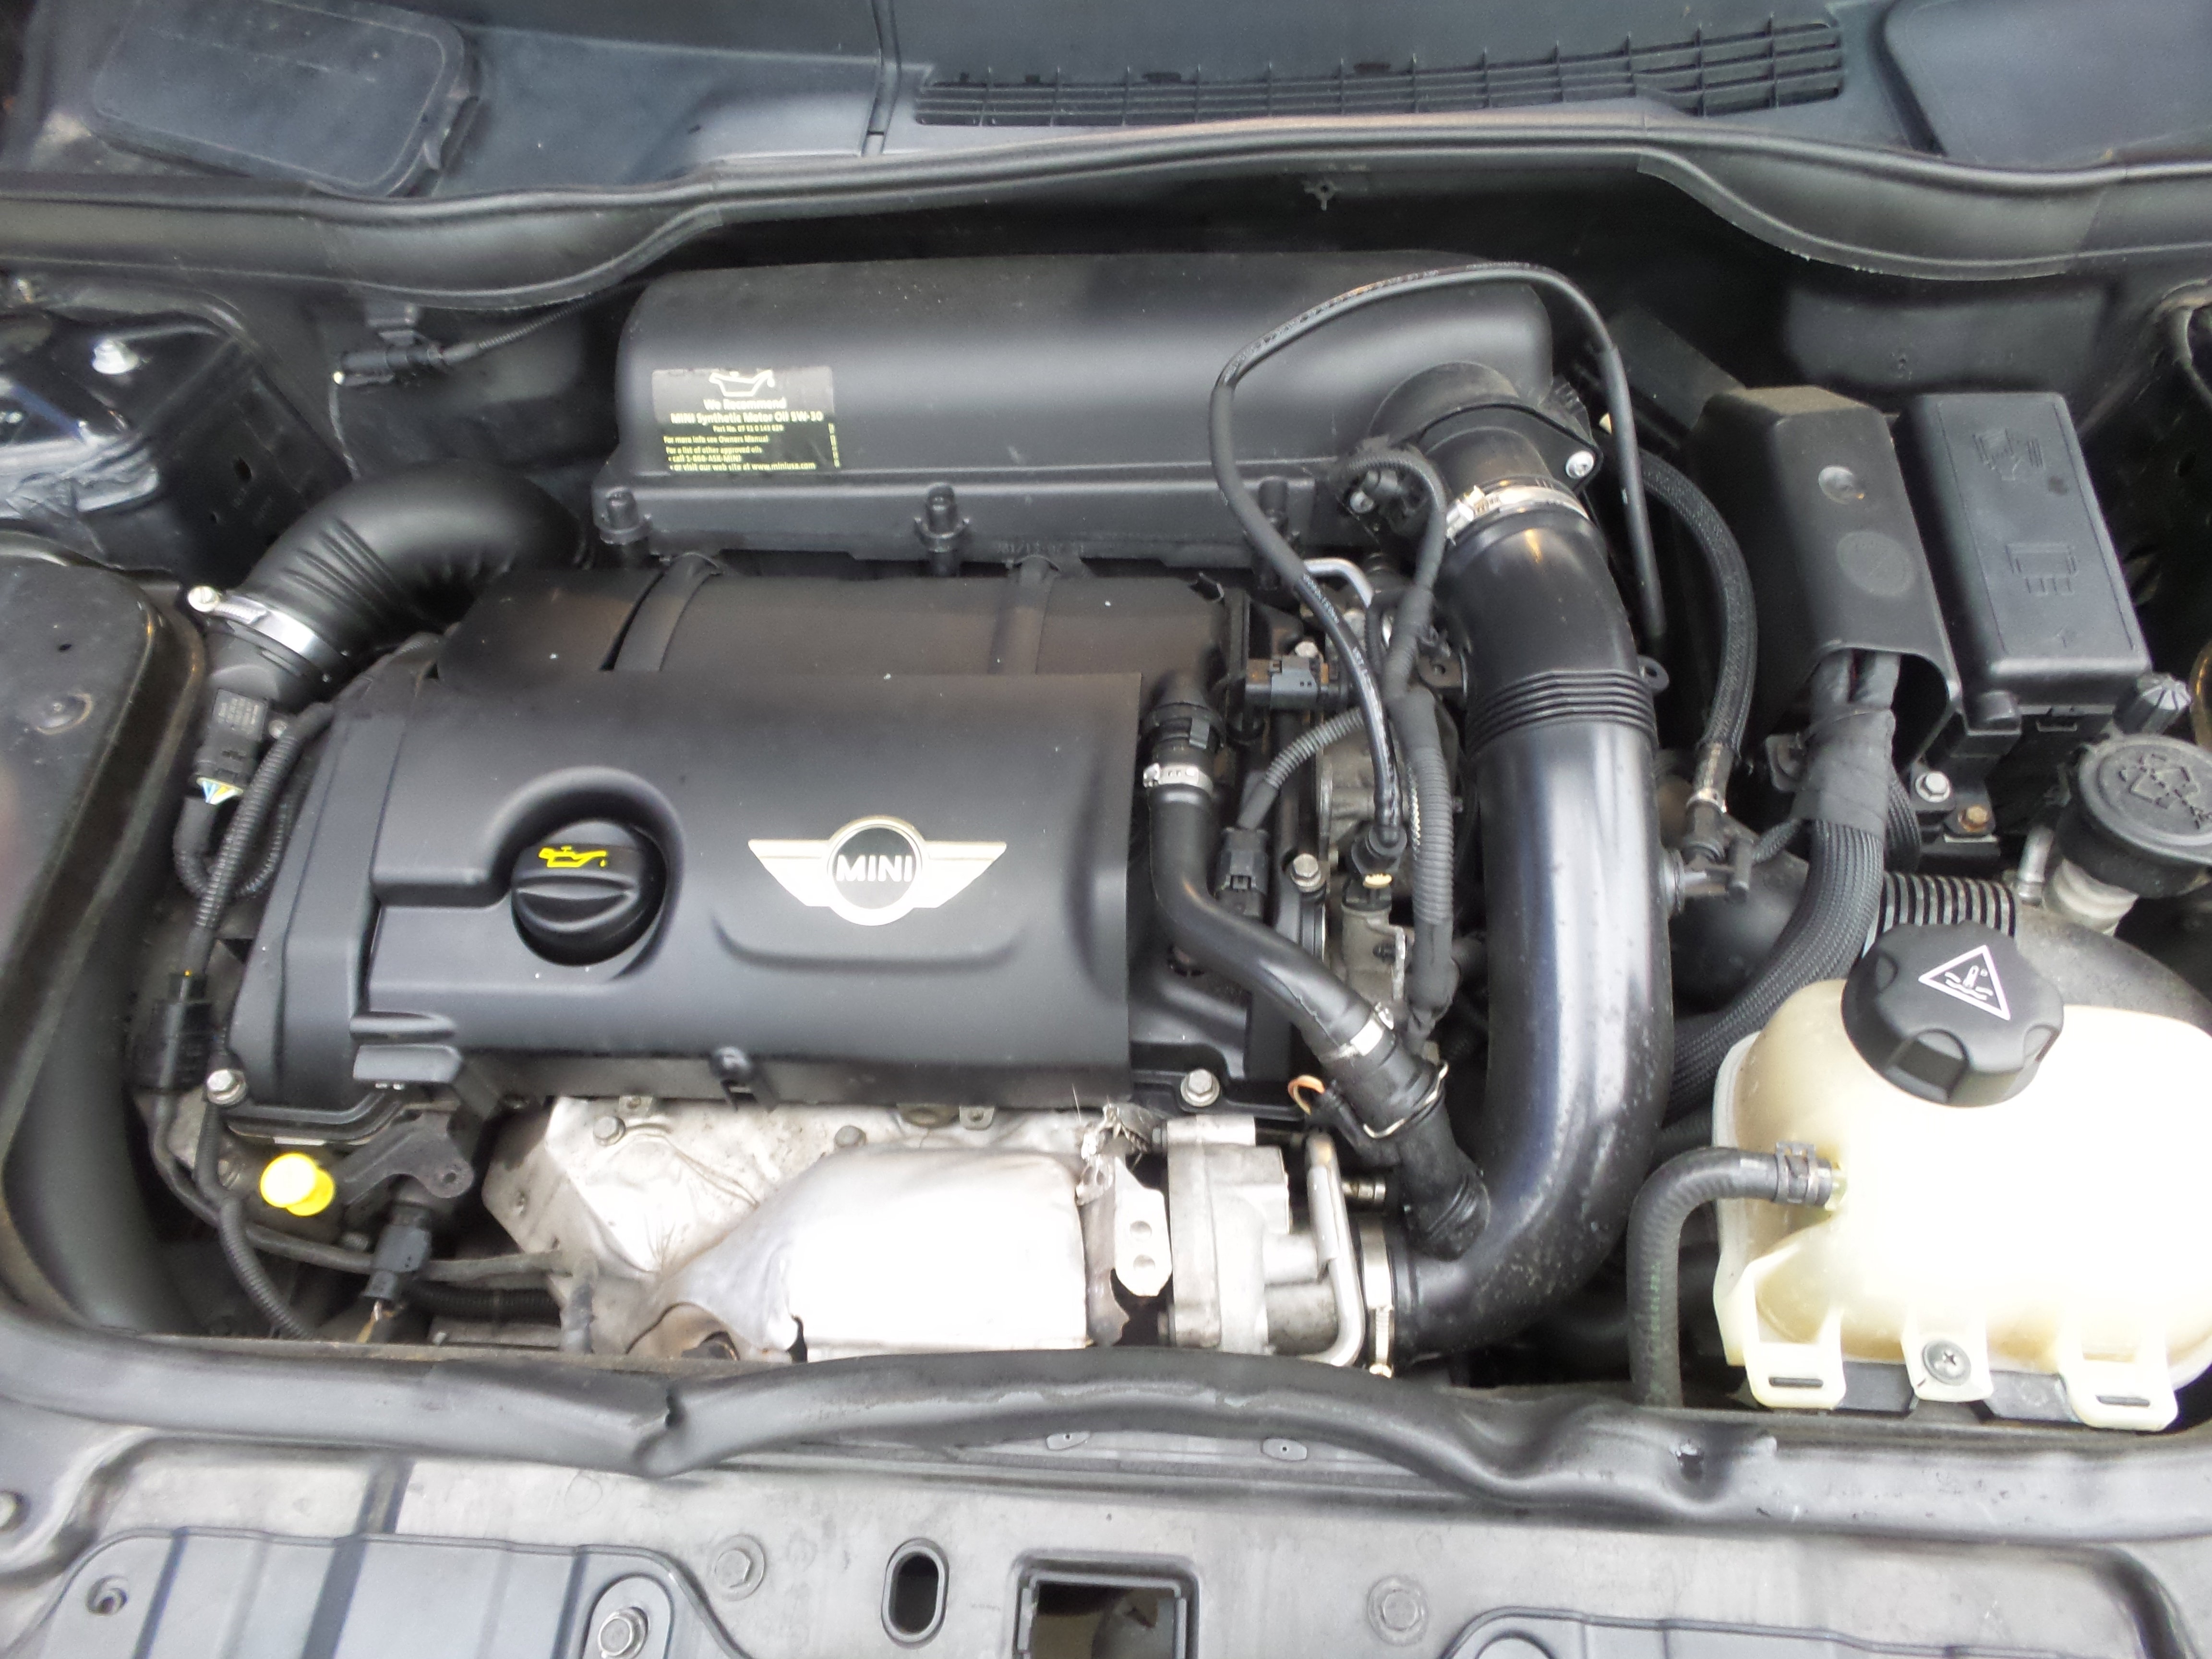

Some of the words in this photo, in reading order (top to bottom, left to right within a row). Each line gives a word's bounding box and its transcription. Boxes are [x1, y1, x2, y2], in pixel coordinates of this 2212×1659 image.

[703, 399, 721, 410] We
[723, 397, 786, 409] Recommend
[671, 412, 696, 423] MINI
[697, 412, 742, 426] Synthetic
[743, 412, 772, 423] Motor
[774, 411, 789, 422] Oil
[791, 411, 823, 421] 5W-30
[721, 446, 750, 455] approved
[673, 454, 685, 462] call
[682, 463, 697, 471] visit
[752, 462, 816, 470] www.miniusa.com
[836, 854, 912, 882] MINI
